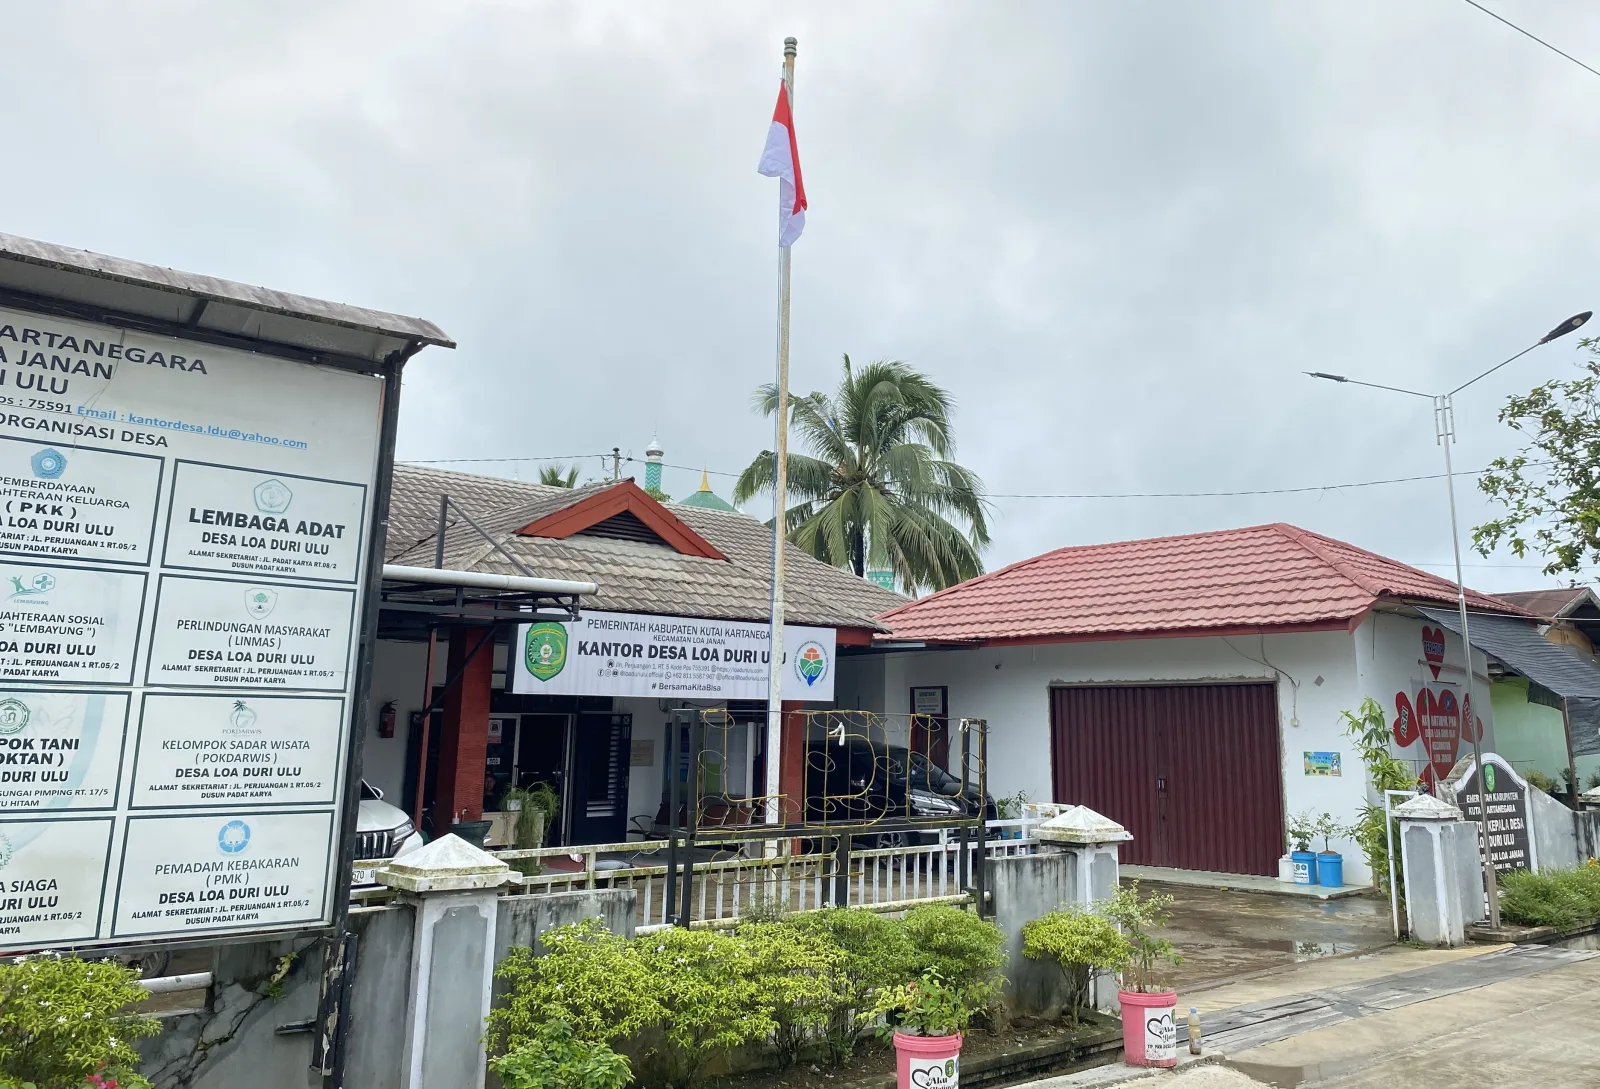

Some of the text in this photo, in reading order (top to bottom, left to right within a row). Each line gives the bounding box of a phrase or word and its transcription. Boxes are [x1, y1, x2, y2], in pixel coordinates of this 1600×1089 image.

[16, 350, 113, 379] JANAN
[16, 372, 68, 394] ULU
[28, 399, 308, 449] 75591 Email kantordesa.ldu@yahoo.com
[121, 431, 168, 448] DESA
[66, 495, 129, 509] KELUARGA
[20, 502, 63, 516] PKK
[8, 517, 38, 529] LOA
[43, 520, 79, 533] DURI
[85, 524, 114, 536] ULU
[189, 508, 345, 539] LEMBAGA ADAT
[23, 544, 50, 553] PADAT
[52, 547, 78, 555] KARYA
[45, 537, 98, 547] PERJUANGAN
[107, 542, 136, 551] RT.05/2
[202, 532, 329, 555] DESA LOA DURI ULU
[216, 552, 258, 561] SEKRETARIAT
[273, 557, 291, 565] PADAT
[293, 558, 313, 566] KARYA
[276, 565, 296, 573] KARYA
[68, 615, 104, 625] SOSIAL
[177, 619, 330, 638] PERLINDUNGAN MASYARAKAT
[588, 619, 770, 639] PEMERINTAH KABUPATEN KUTAI KARTANEGA
[235, 636, 275, 647] LINMAS
[654, 635, 692, 644] KECAMATAN
[24, 643, 96, 655] DURI ULU
[578, 641, 644, 658] KANTOR
[648, 644, 688, 660] DESA
[692, 648, 719, 661] LOA
[724, 650, 756, 663] DURI
[188, 649, 314, 664] DESA LOA DURI ULU
[25, 660, 79, 668] PERJUANGAN
[89, 662, 119, 670] RT.05/2
[161, 664, 191, 672] ALAMAT
[194, 665, 242, 673] SEKRETARIAT
[258, 667, 301, 676] PERJUANGAN
[659, 683, 721, 691] BersamaKitaBisa
[40, 739, 79, 750] TANI
[162, 740, 310, 750] KELOMPOK SADAR WISATA
[203, 753, 271, 763] POKDARWIS
[2, 771, 68, 783] DURI ULU
[175, 767, 301, 777] DESA LOA DURI ULU
[1493, 792, 1518, 801] KABUPATEN
[1469, 804, 1516, 815] KUTA ARTANEGARA
[1488, 819, 1509, 832] KEPALA
[1510, 818, 1524, 829] DESA
[1489, 834, 1502, 847] DURI
[1503, 834, 1514, 845] ULU
[1499, 851, 1508, 859] LOA
[1509, 850, 1524, 858] JANAN
[155, 857, 299, 875] PEMADAM KEBAKARAN
[214, 874, 242, 885] PMK
[11, 879, 57, 893] SIAGA
[159, 885, 289, 904] DESA LOA DURI ULU
[27, 896, 58, 908] ULU
[132, 910, 162, 919] ALAMAT
[165, 907, 214, 917] SEKRETARIAT
[230, 903, 275, 912] PERJUANGAN
[283, 900, 309, 908] RT.05/2
[51, 912, 82, 921] RT.05/2
[185, 913, 259, 925] DUSUN PADAT KARYA
